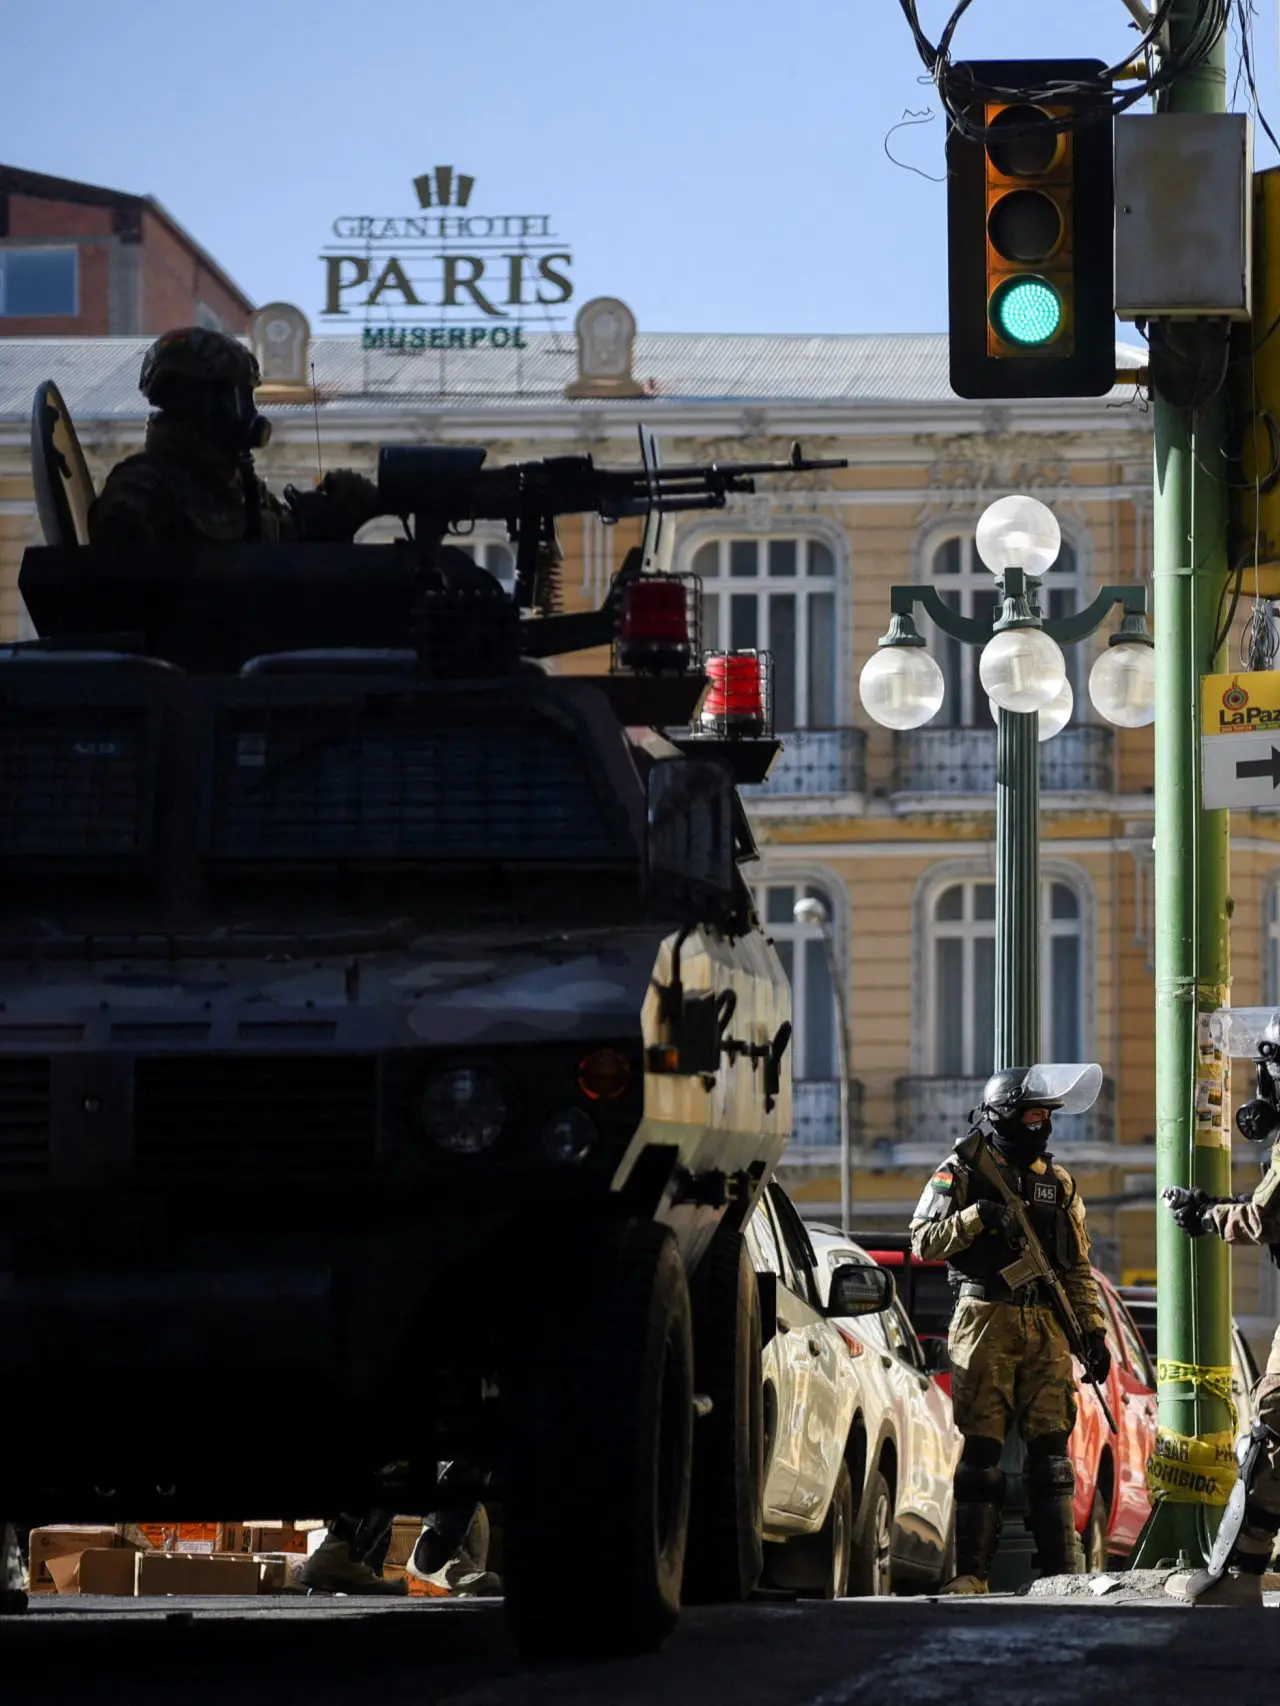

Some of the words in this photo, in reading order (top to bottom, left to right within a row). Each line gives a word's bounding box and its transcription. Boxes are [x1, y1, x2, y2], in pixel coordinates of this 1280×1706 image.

[332, 215, 428, 239] GRAN
[437, 214, 559, 238] HOTEL
[318, 253, 574, 318] PARIS
[361, 325, 528, 349] MUSERPOL
[1036, 1186, 1055, 1200] 145
